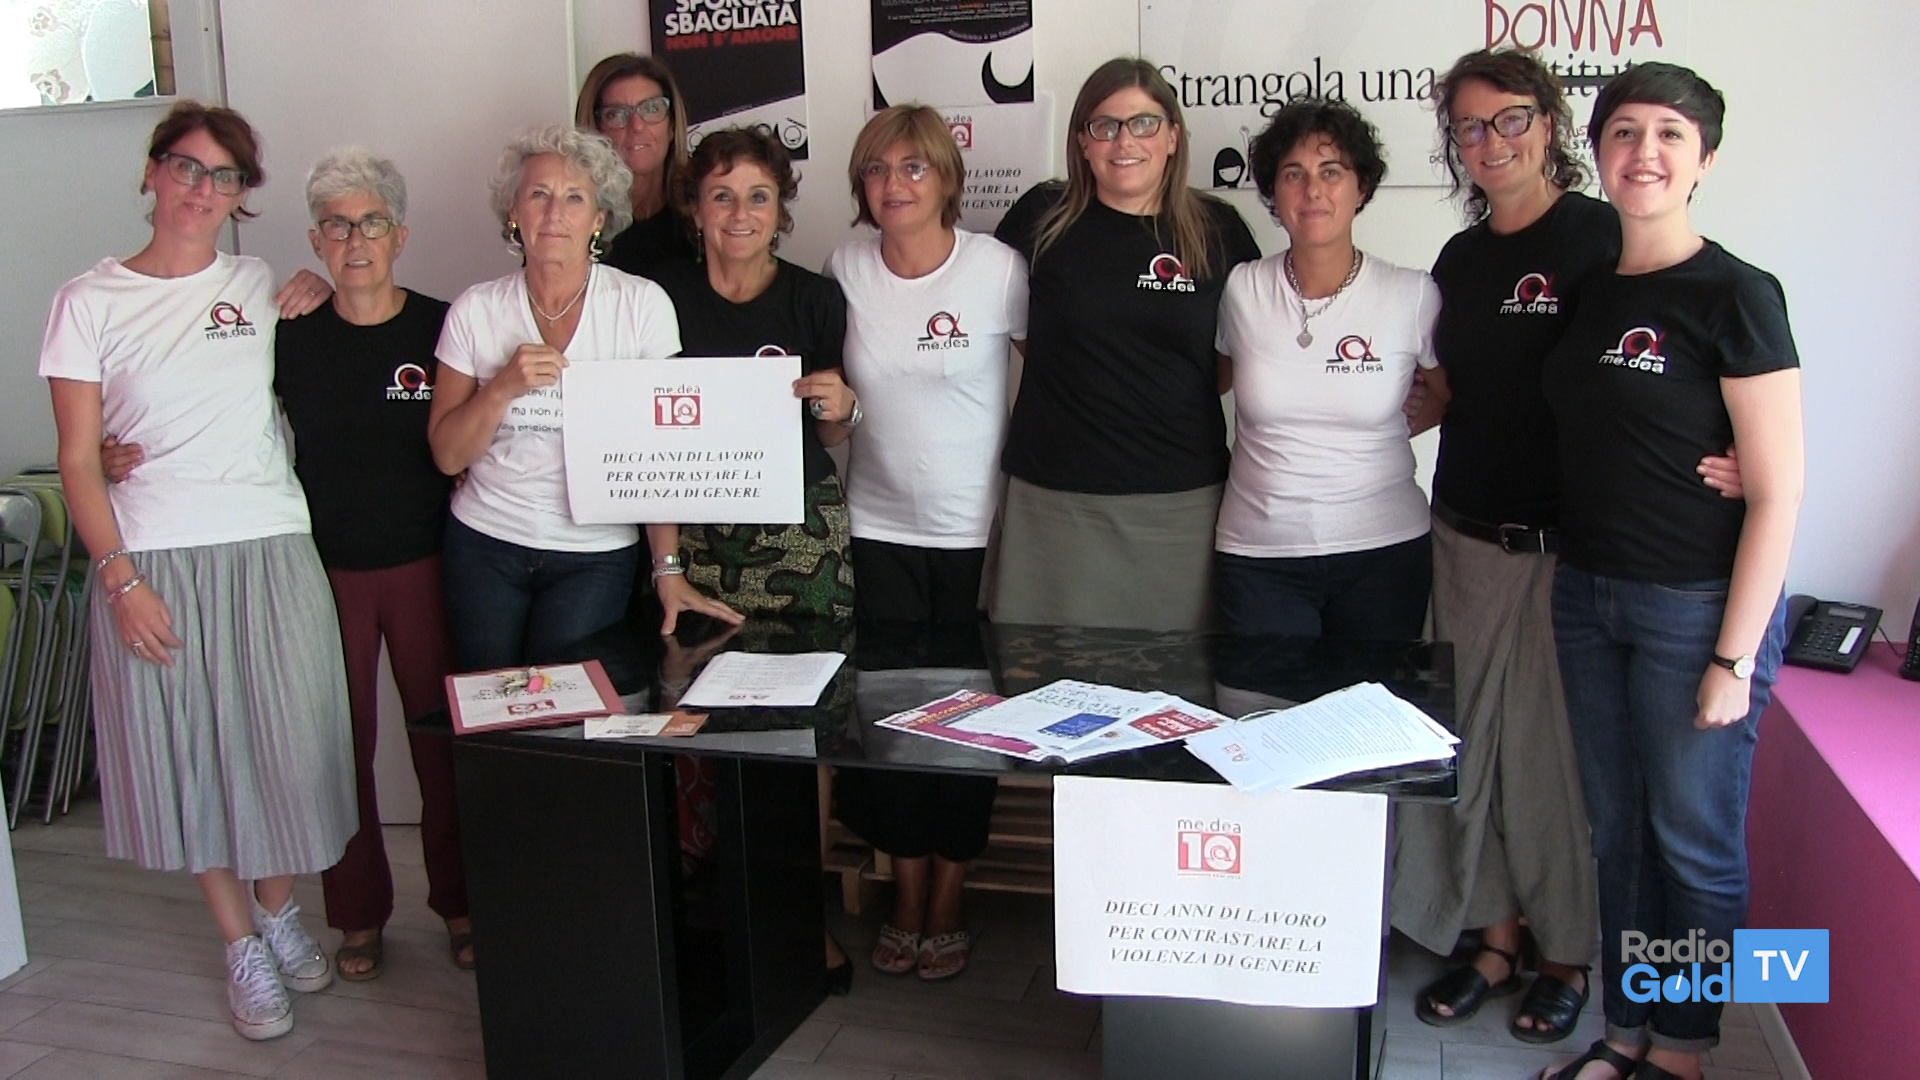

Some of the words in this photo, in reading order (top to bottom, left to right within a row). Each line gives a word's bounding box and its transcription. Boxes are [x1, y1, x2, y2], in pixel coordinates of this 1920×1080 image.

[665, 3, 798, 36] SBAGLIATA
[1485, 0, 1663, 56] DONNA
[665, 34, 709, 50] NON
[730, 25, 798, 45] AMORE
[1157, 56, 1344, 117] Strangola
[1359, 67, 1437, 102] una
[975, 169, 1022, 178] LAVORO
[1004, 185, 1020, 194] LA
[1136, 277, 1196, 293] me.dea
[1499, 300, 1558, 315] me.dea
[206, 328, 256, 340] me.dea
[917, 338, 969, 351] me.dea
[1325, 358, 1384, 374] me.dea
[1598, 353, 1664, 375] me.dea
[386, 389, 433, 401] me.de
[653, 384, 701, 394] me.dea
[603, 452, 643, 464] DIECI
[646, 451, 683, 463] ANNI
[686, 451, 702, 462] DI
[705, 450, 765, 462] LAVORO
[606, 471, 634, 482] PER
[637, 469, 740, 482] CONTRASTARE
[743, 469, 762, 480] LA
[609, 488, 680, 499] VIOLENZA
[684, 487, 700, 498] DI
[703, 487, 763, 498] GENERE
[1177, 817, 1241, 834] me.dea
[1104, 900, 1159, 916] DIECI
[1163, 903, 1215, 919] ANNI
[1219, 905, 1241, 920] DI
[1246, 908, 1328, 928] LAVORO
[1108, 925, 1145, 941] PER
[1150, 926, 1292, 951] CONTRASTARE
[1297, 937, 1322, 953] LA
[1110, 947, 1207, 965] VIOLENZA
[1213, 952, 1235, 967] DI
[1239, 956, 1322, 974] GENERE
